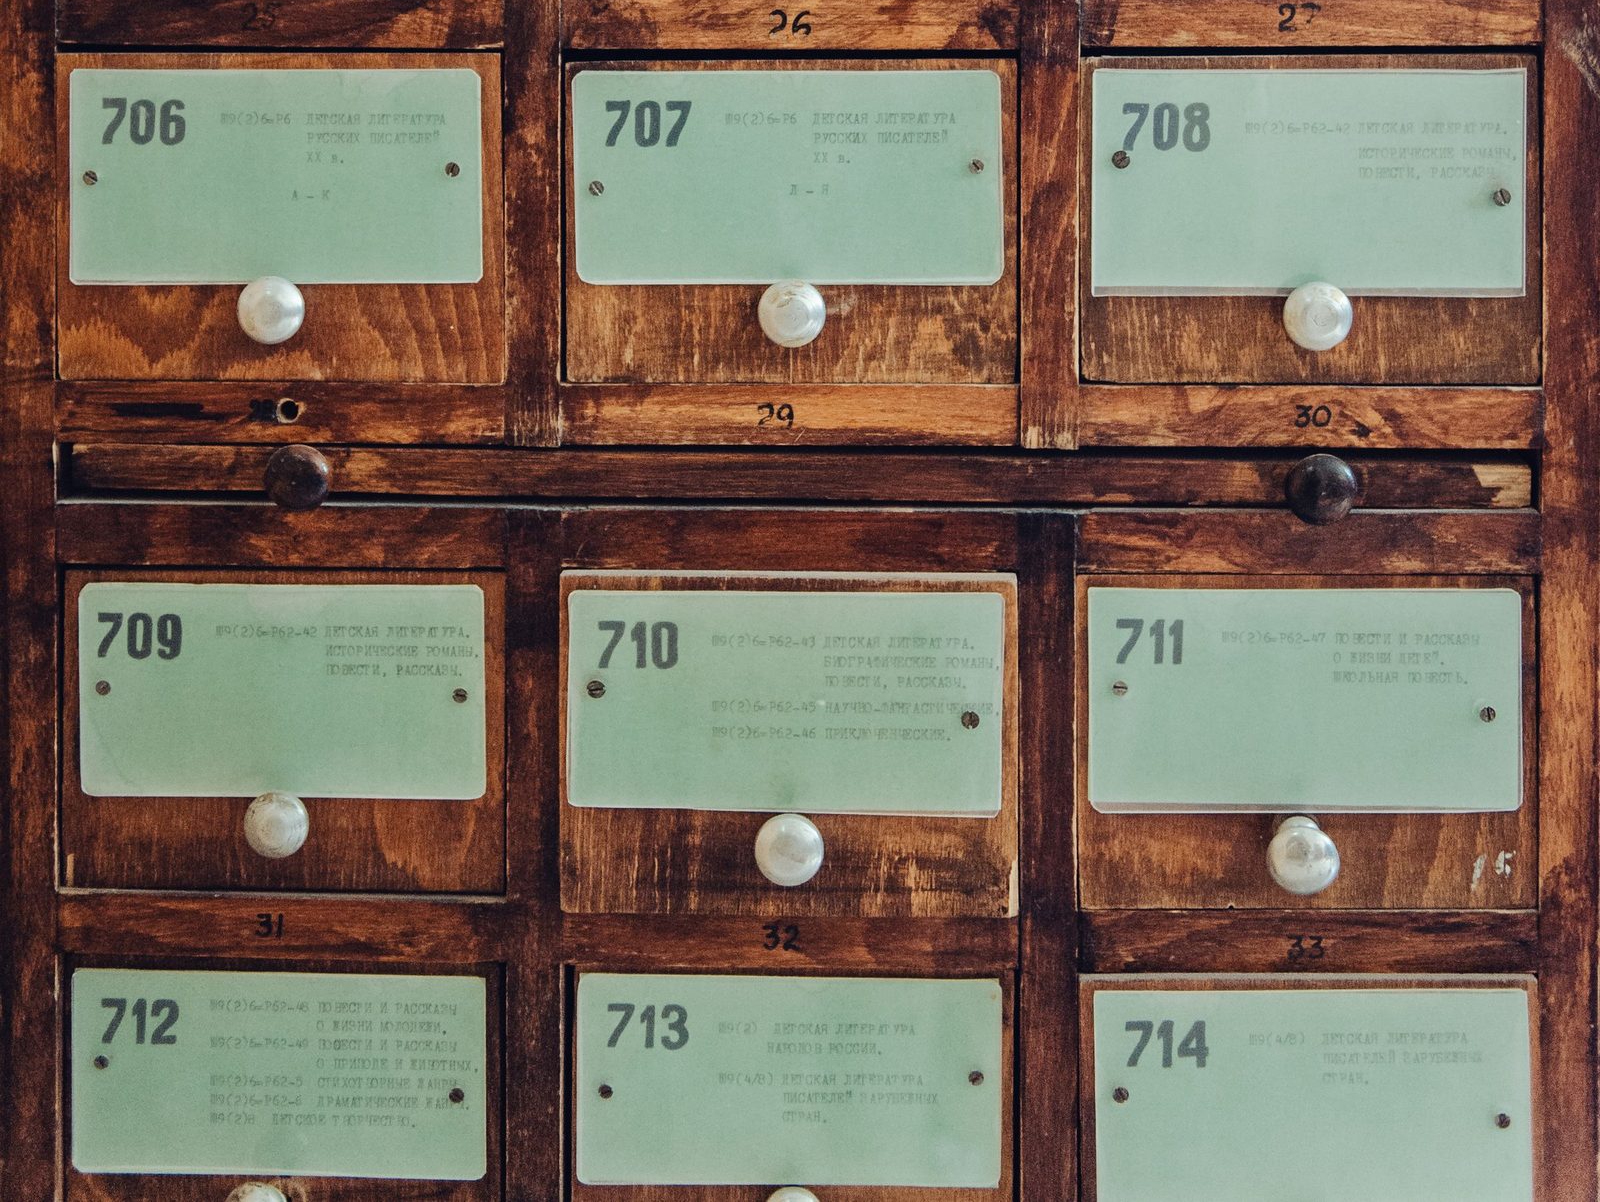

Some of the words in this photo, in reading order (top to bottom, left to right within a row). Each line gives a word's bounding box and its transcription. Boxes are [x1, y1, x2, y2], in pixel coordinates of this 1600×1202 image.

[768, 9, 813, 37] 26
[102, 98, 185, 145] 706
[305, 113, 361, 125] ДЕТСКАЯ
[367, 113, 446, 125] ЛИТЕРАТУРА
[606, 100, 691, 147] 707
[812, 113, 869, 125] ДЕТСКАЯ
[874, 112, 956, 124] ЛИТЕРАТУРА
[1122, 103, 1210, 150] 708
[1358, 122, 1414, 134] ДЕТСКАЯ
[1421, 121, 1508, 135] ЛИТЕРАТУРА.
[306, 131, 360, 144] РУССКИХ
[813, 131, 868, 144] РУССКИХ
[877, 130, 948, 143] ПИСАТЕЛЕЙ
[757, 403, 794, 430] 29
[1294, 404, 1333, 428] 30
[98, 613, 182, 660] 709
[324, 626, 379, 638] ДЕТСКАЯ
[386, 626, 470, 639] ЛИТЕРАТУРА.
[1335, 633, 1392, 645] ПОВЕСТИ
[1399, 633, 1407, 645] И
[1415, 633, 1480, 646] РАССКАЗЫ
[599, 621, 678, 669] 710
[823, 636, 881, 649] ДЕТСКАЯ
[888, 636, 975, 650] ЛИТЕРАТУРА.
[1116, 619, 1183, 664] 711
[325, 645, 419, 657] ИСТОРИЧЕСКИЕ
[824, 656, 937, 669] БИОГРАФИЧЕСКИЕ
[326, 664, 387, 678] ПОВЕСТИ,
[396, 664, 463, 676] РАССКАЗЫ.
[1333, 671, 1399, 683] ШКОЛЬНАЯ
[1407, 671, 1468, 685] ПОВЕСТЬ.
[255, 913, 285, 939] 31
[762, 924, 802, 951] 32
[1287, 934, 1325, 961] 33
[101, 998, 179, 1044] 712
[332, 1020, 373, 1032] ЖИЗНИ
[608, 1003, 689, 1050] 713
[773, 1023, 828, 1036] ДЕТСКАЯ
[835, 1023, 915, 1036] ЛИТЕРАТУРА
[1125, 1020, 1208, 1068] 714
[1321, 1032, 1378, 1046] ДЕТСКАЯ
[1386, 1032, 1467, 1045] ЛИТЕРАТУРА
[767, 1043, 822, 1055] НАРОДОВ
[829, 1043, 882, 1056] РОССИИ.
[272, 1113, 326, 1126] ДЕТСКОЕ
[332, 1114, 416, 1128] ТВОРЧЕСТВО.
